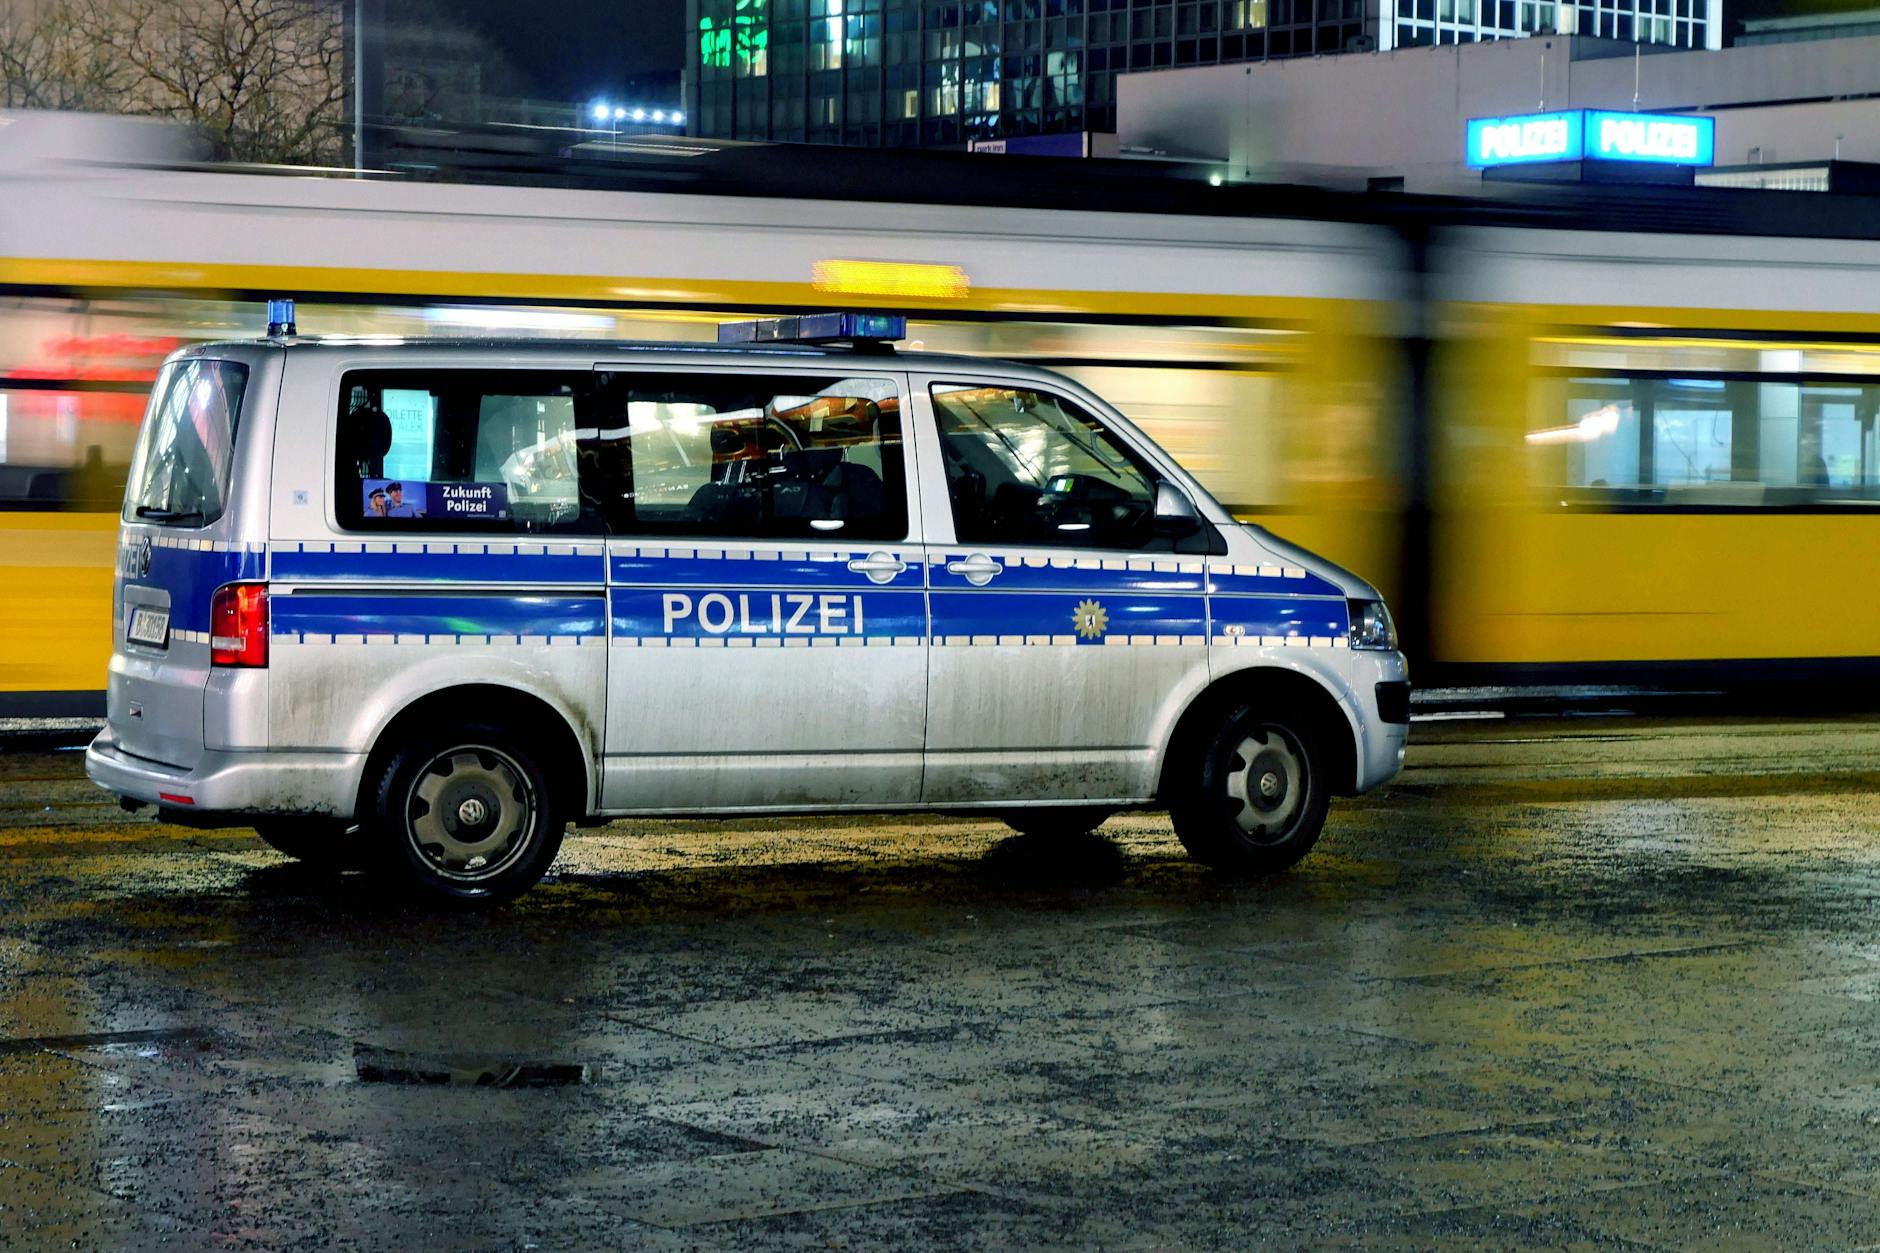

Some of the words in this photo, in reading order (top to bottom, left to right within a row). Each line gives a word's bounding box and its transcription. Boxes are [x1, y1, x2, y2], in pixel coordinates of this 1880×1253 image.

[1481, 120, 1568, 159] POLIZEI
[1601, 118, 1697, 158] POLIZEI
[442, 486, 492, 499] Zukunft
[447, 500, 487, 512] Polizei
[662, 592, 864, 635] POLIZEI
